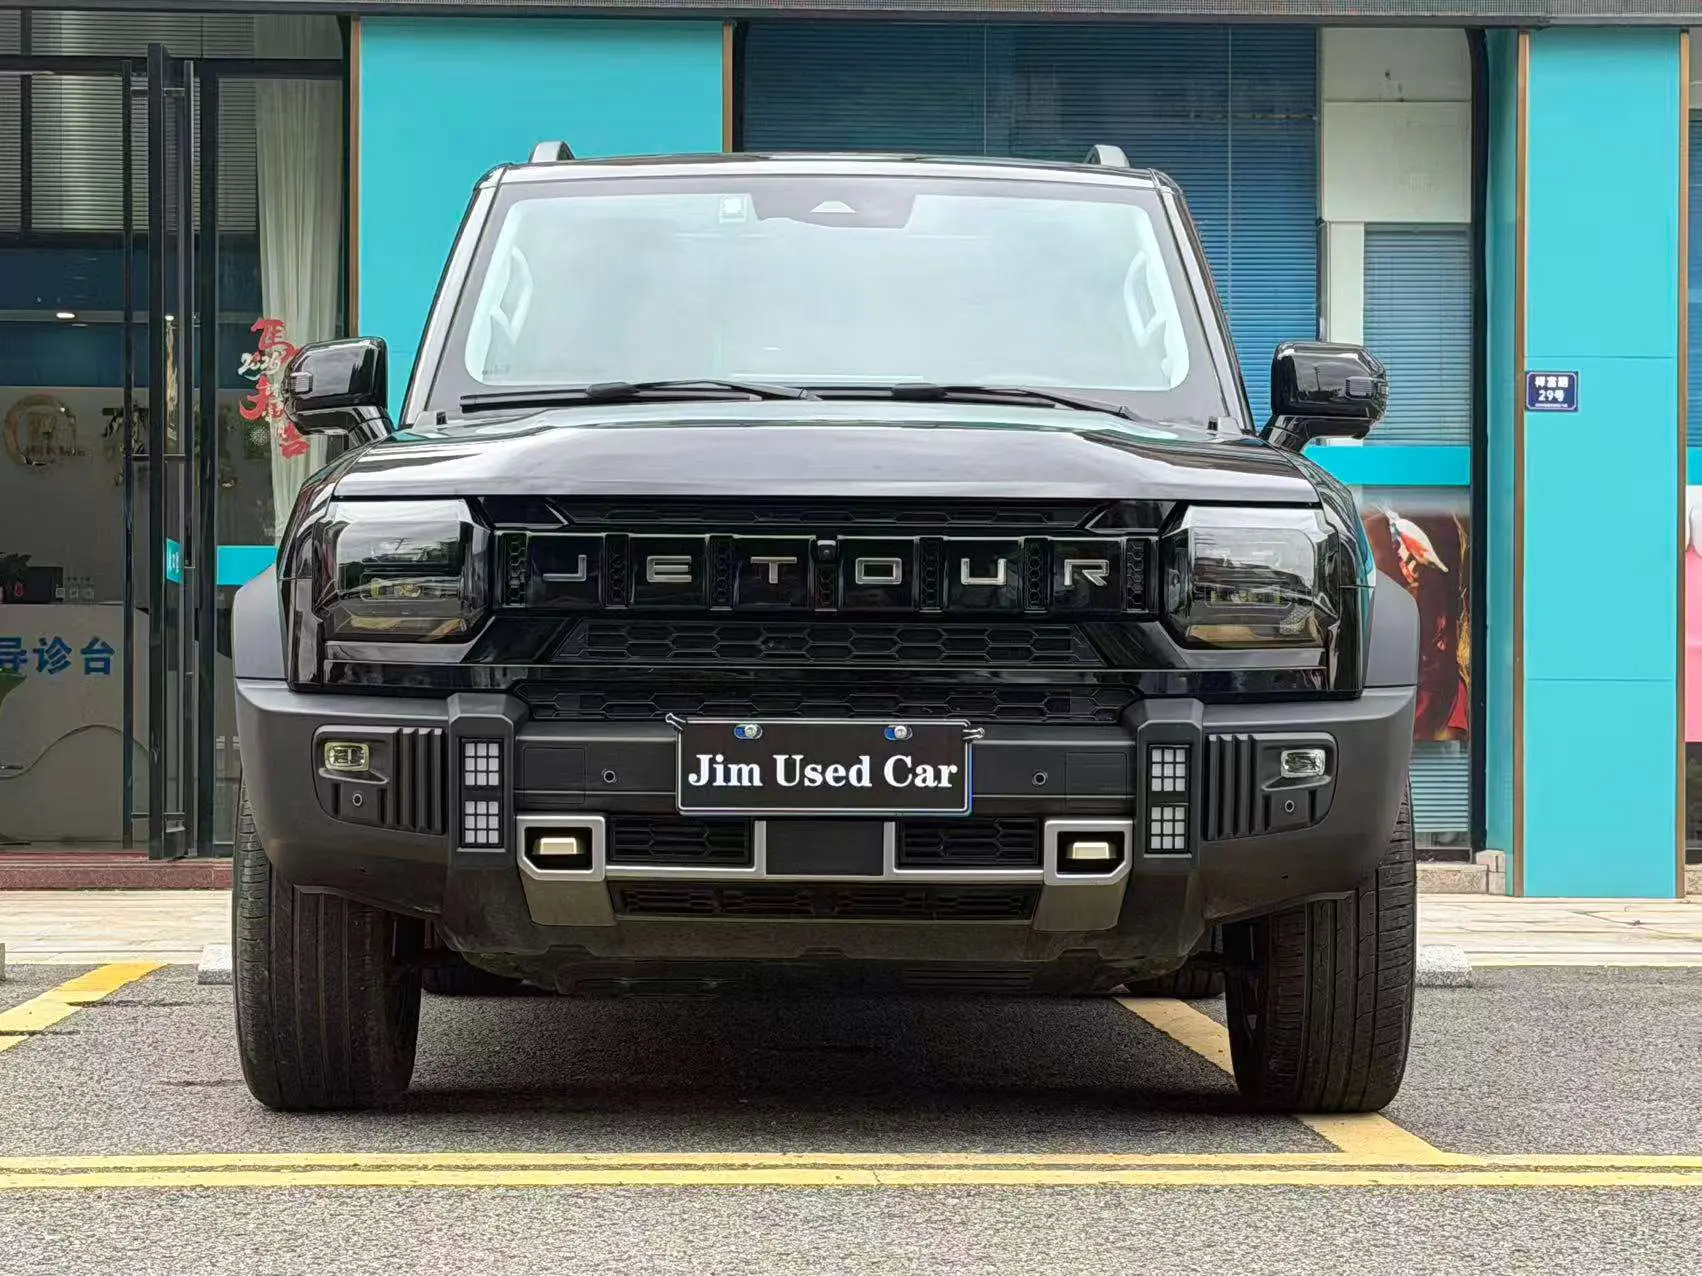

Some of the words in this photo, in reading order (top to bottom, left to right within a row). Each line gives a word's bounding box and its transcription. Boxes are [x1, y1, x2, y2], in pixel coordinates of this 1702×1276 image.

[1538, 389, 1565, 402] 29号
[542, 554, 1109, 586] JETOUR
[688, 754, 763, 787] Jim
[773, 754, 872, 787] Used
[883, 755, 957, 788] Car
